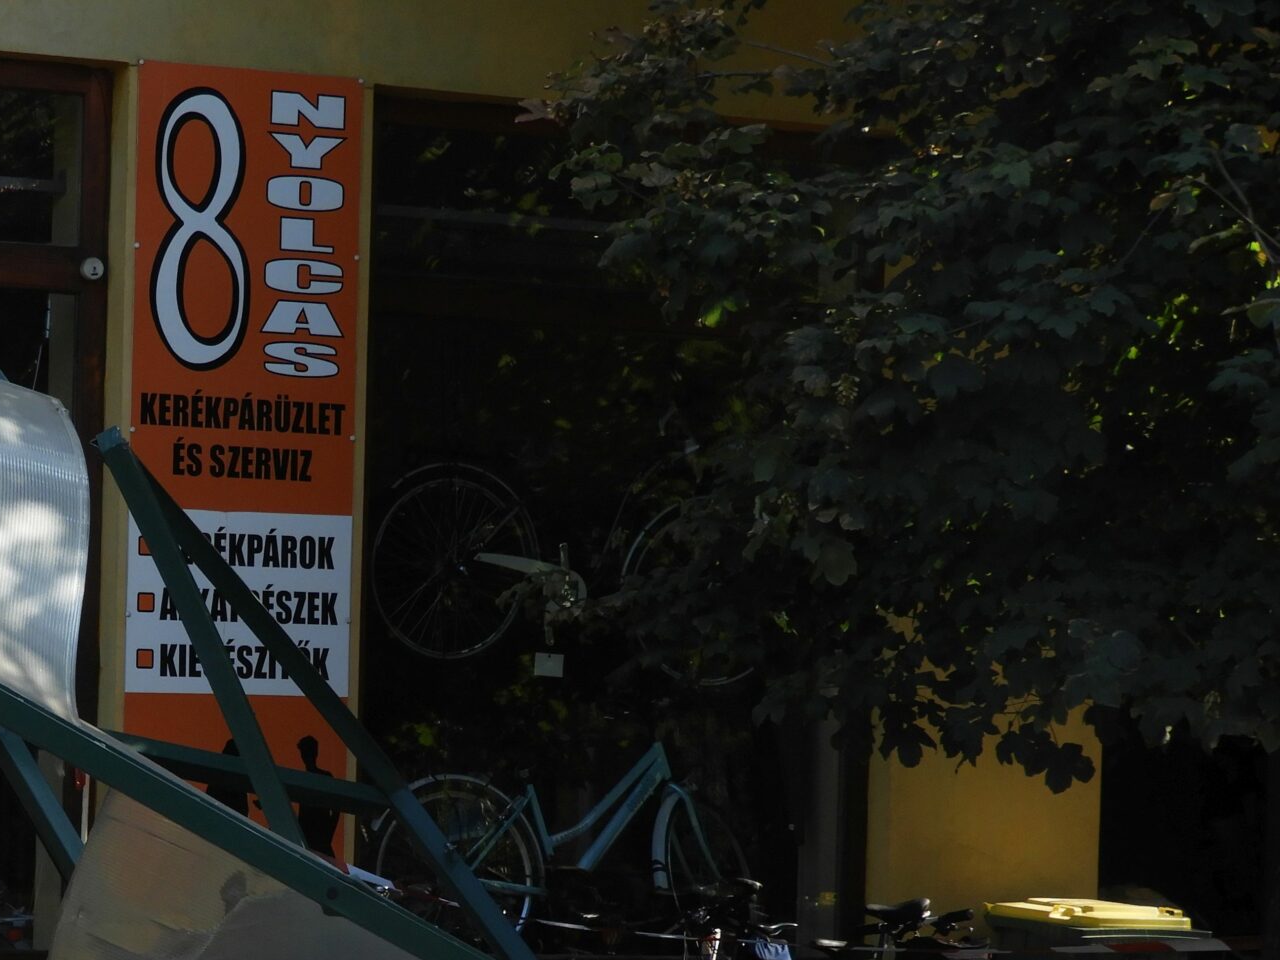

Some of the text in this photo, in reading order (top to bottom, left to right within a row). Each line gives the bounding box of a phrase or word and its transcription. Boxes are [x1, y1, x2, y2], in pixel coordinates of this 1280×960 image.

[149, 86, 250, 371] 8
[260, 90, 348, 378] NYOLCAS
[140, 389, 345, 435] KERÉKPÁRÜZLET
[173, 437, 313, 482] ÉS SZERVIZ
